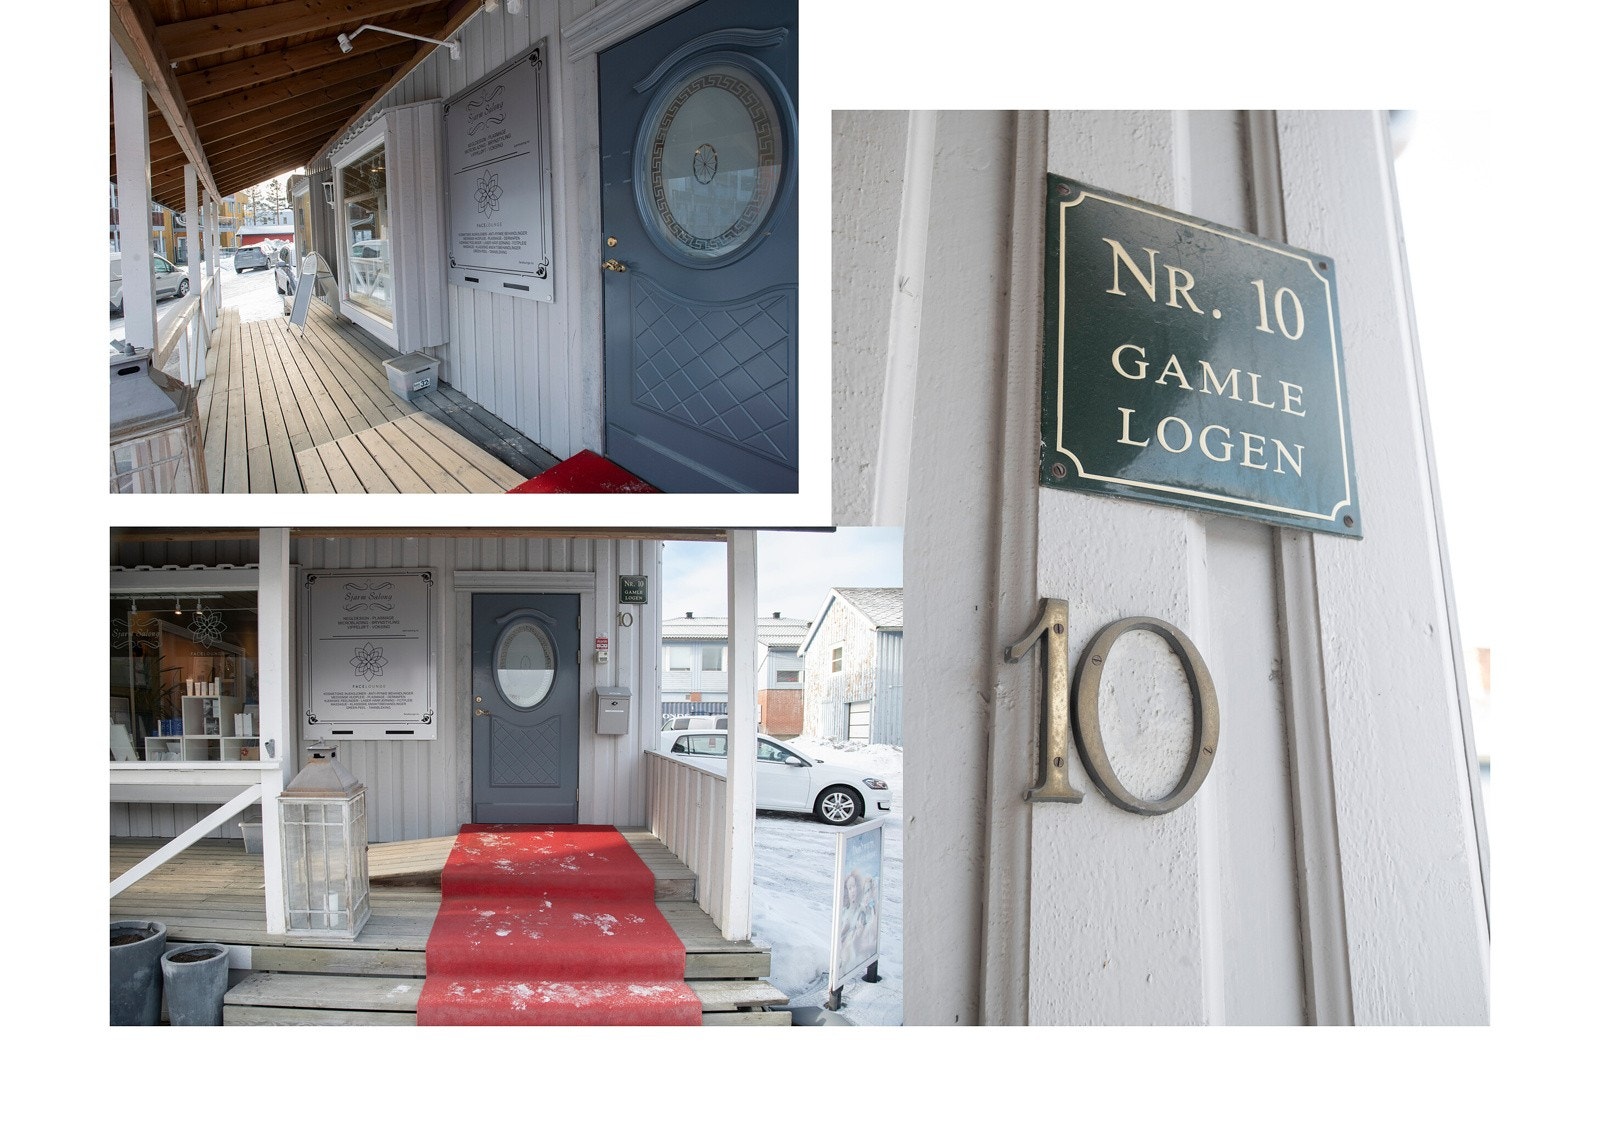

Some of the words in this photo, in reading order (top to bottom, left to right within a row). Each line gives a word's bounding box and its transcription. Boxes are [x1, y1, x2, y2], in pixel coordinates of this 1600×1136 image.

[1250, 278, 1304, 342] 10
[1111, 344, 1306, 418] GAMLE
[1117, 407, 1305, 477] LOGEN
[616, 611, 633, 627] 10
[1004, 597, 1220, 817] 10
